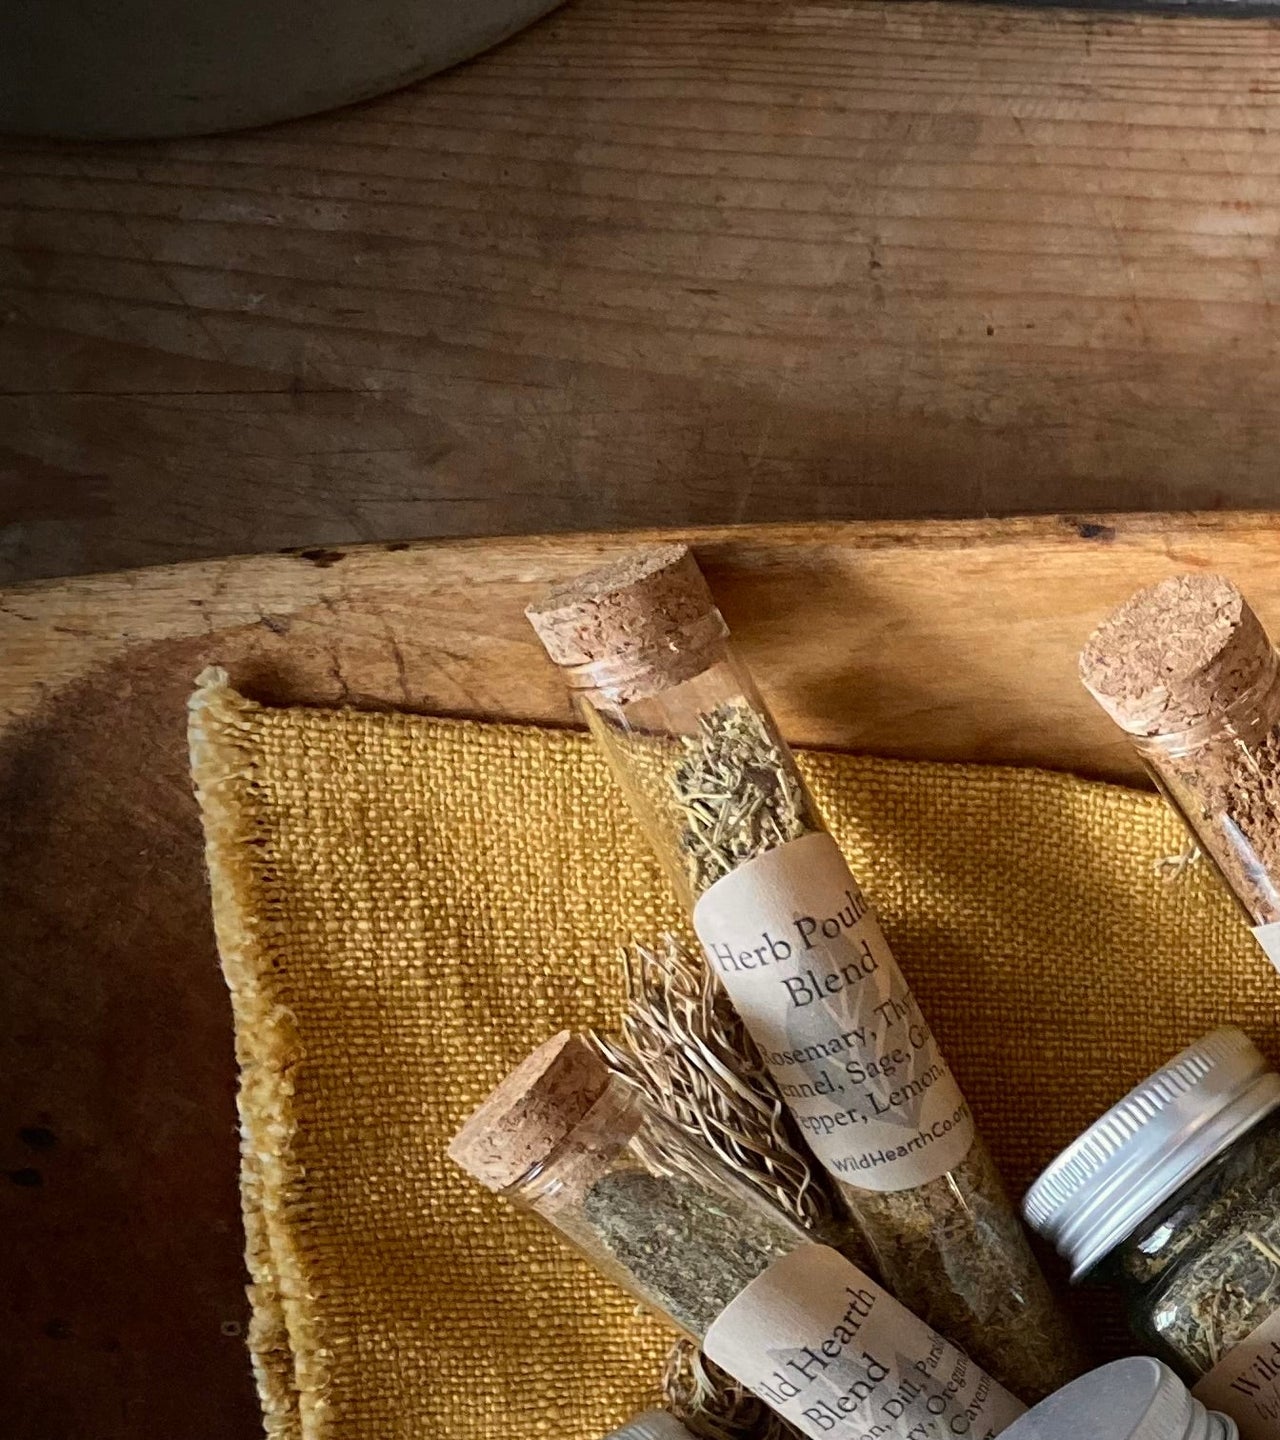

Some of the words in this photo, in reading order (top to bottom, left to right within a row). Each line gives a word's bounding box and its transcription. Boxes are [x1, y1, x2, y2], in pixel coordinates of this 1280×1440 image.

[711, 932, 791, 973] Herb
[782, 940, 879, 1008] Blend
[846, 1049, 911, 1086] Sage,
[787, 1287, 875, 1380] Hearth
[801, 1351, 890, 1432] Blend
[882, 1379, 927, 1420] Dill,
